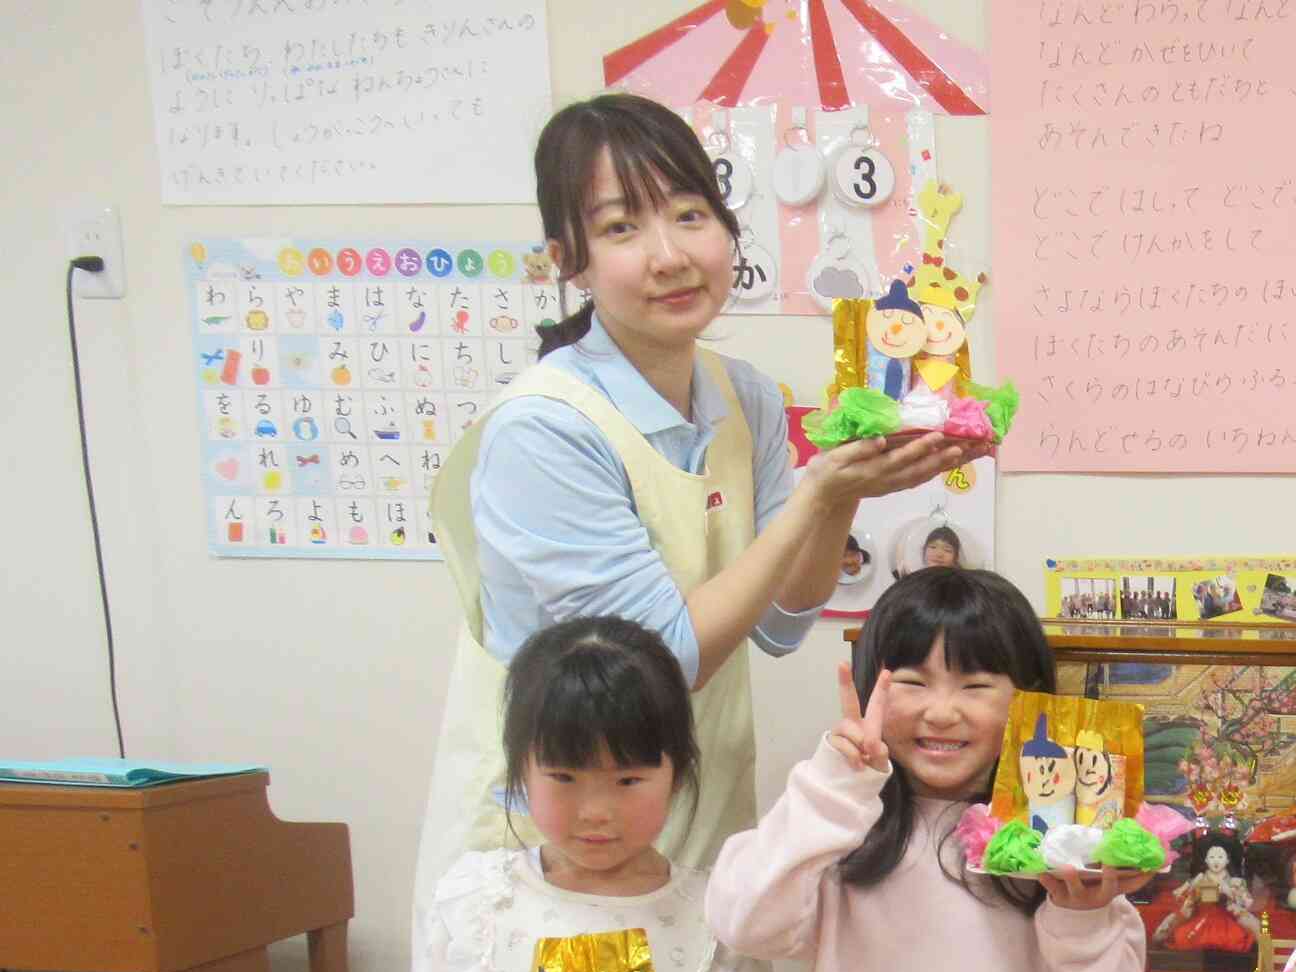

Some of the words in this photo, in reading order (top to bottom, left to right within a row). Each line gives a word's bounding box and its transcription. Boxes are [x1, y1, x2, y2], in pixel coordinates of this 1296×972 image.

[853, 156, 877, 199] 3
[733, 258, 767, 289] か
[204, 285, 226, 306] わ
[248, 285, 265, 307] ら
[283, 286, 306, 309] や
[326, 286, 342, 309] ま
[365, 286, 386, 308] は
[406, 286, 427, 310] な
[449, 286, 470, 310] た
[492, 287, 510, 310] さ
[535, 288, 557, 309] か
[251, 339, 265, 359] り
[328, 341, 349, 361] み
[370, 341, 389, 362] ひ
[411, 342, 431, 362] に
[454, 342, 473, 364] ち
[499, 342, 513, 365] し
[216, 394, 233, 415] を
[254, 394, 271, 415] る
[293, 393, 312, 415] ゆ
[335, 396, 353, 415] む
[373, 396, 395, 416] ふ
[415, 397, 437, 416] ぬ
[457, 400, 478, 415] つ
[258, 447, 280, 468] れ
[339, 449, 361, 468] め
[379, 453, 401, 466] へ
[224, 500, 242, 520] ん
[267, 500, 284, 521] ろ
[307, 500, 323, 523] よ
[348, 500, 365, 523] も
[386, 502, 407, 523] ほ
